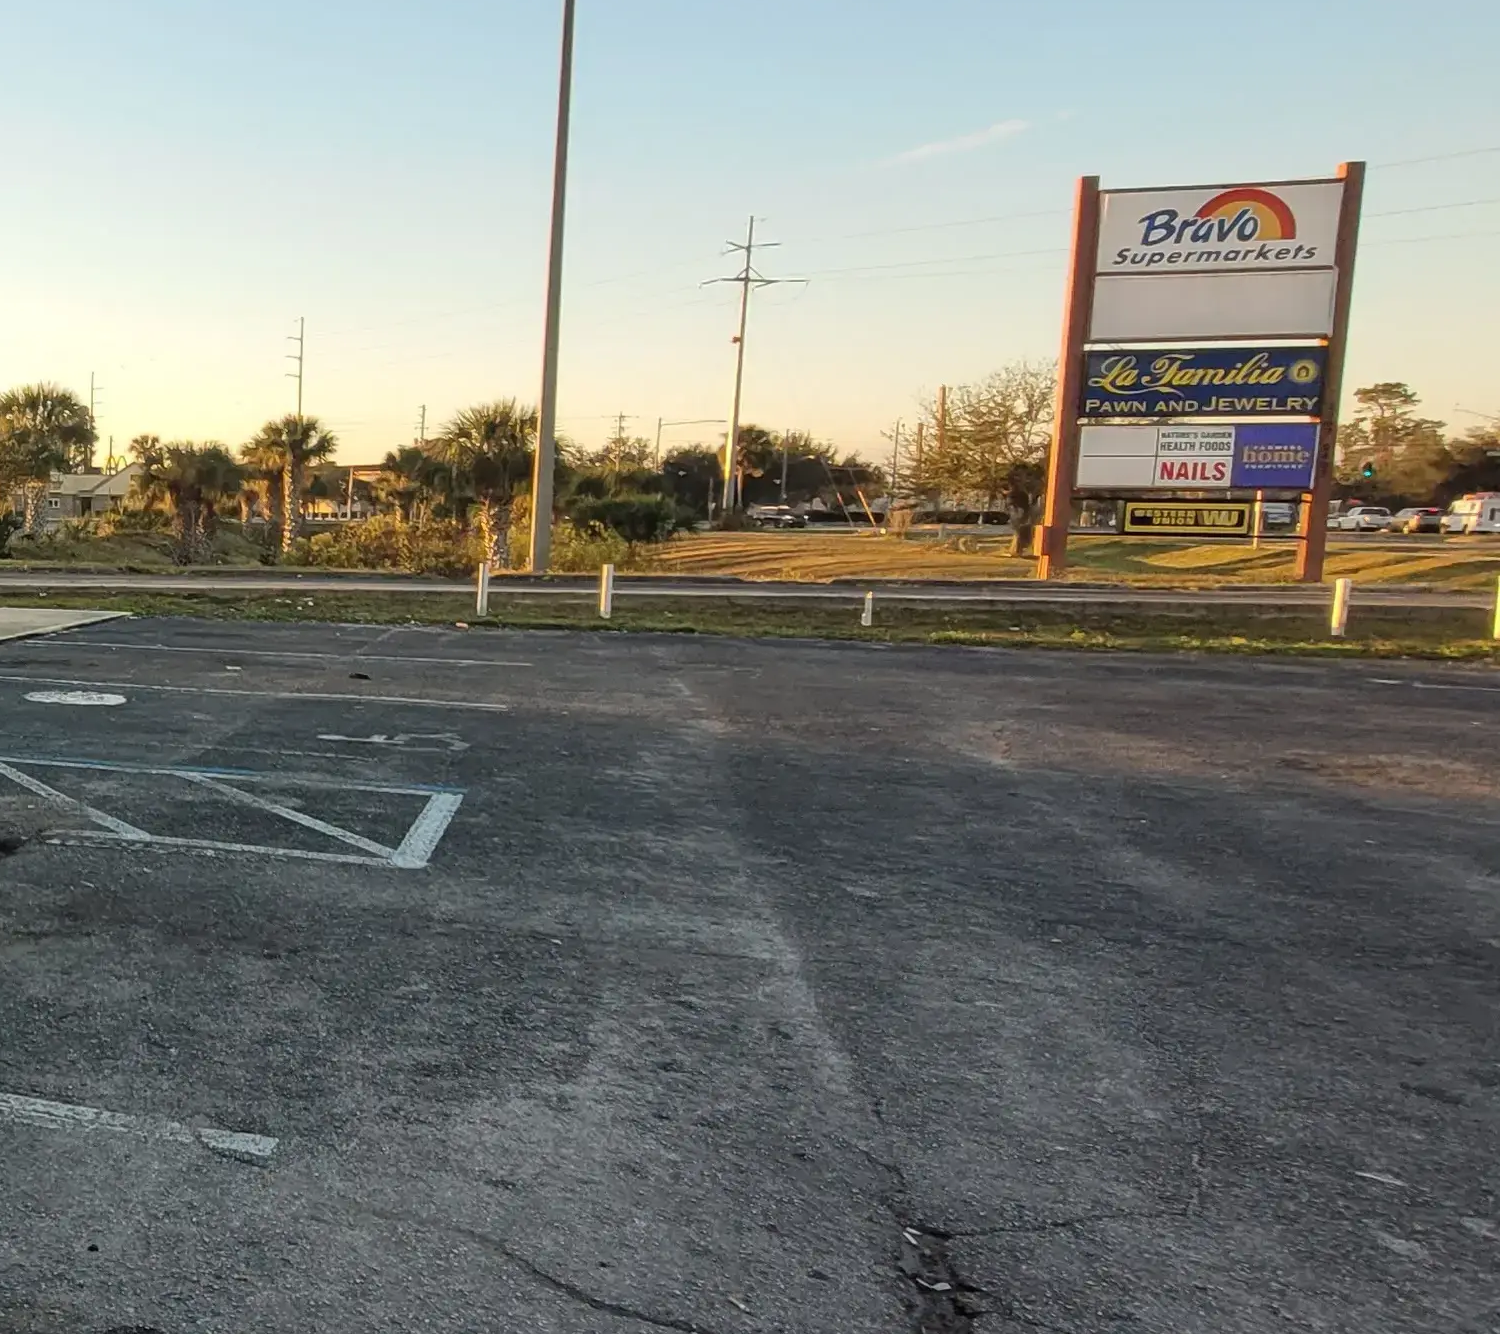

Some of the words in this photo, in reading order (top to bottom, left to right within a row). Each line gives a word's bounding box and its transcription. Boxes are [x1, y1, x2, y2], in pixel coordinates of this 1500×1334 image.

[1138, 208, 1259, 246] Bravo
[1112, 244, 1317, 267] Supermarkets
[1088, 355, 1162, 396] La
[1141, 352, 1284, 386] Familia
[1085, 398, 1147, 413] PAWN
[1154, 399, 1199, 413] AND
[1202, 396, 1318, 412] JEWELRY
[1160, 441, 1196, 452] HEALTH
[1199, 441, 1232, 452] FOODS
[1243, 446, 1310, 463] home
[1160, 461, 1226, 481] NAILS
[1152, 517, 1196, 525] UNION
